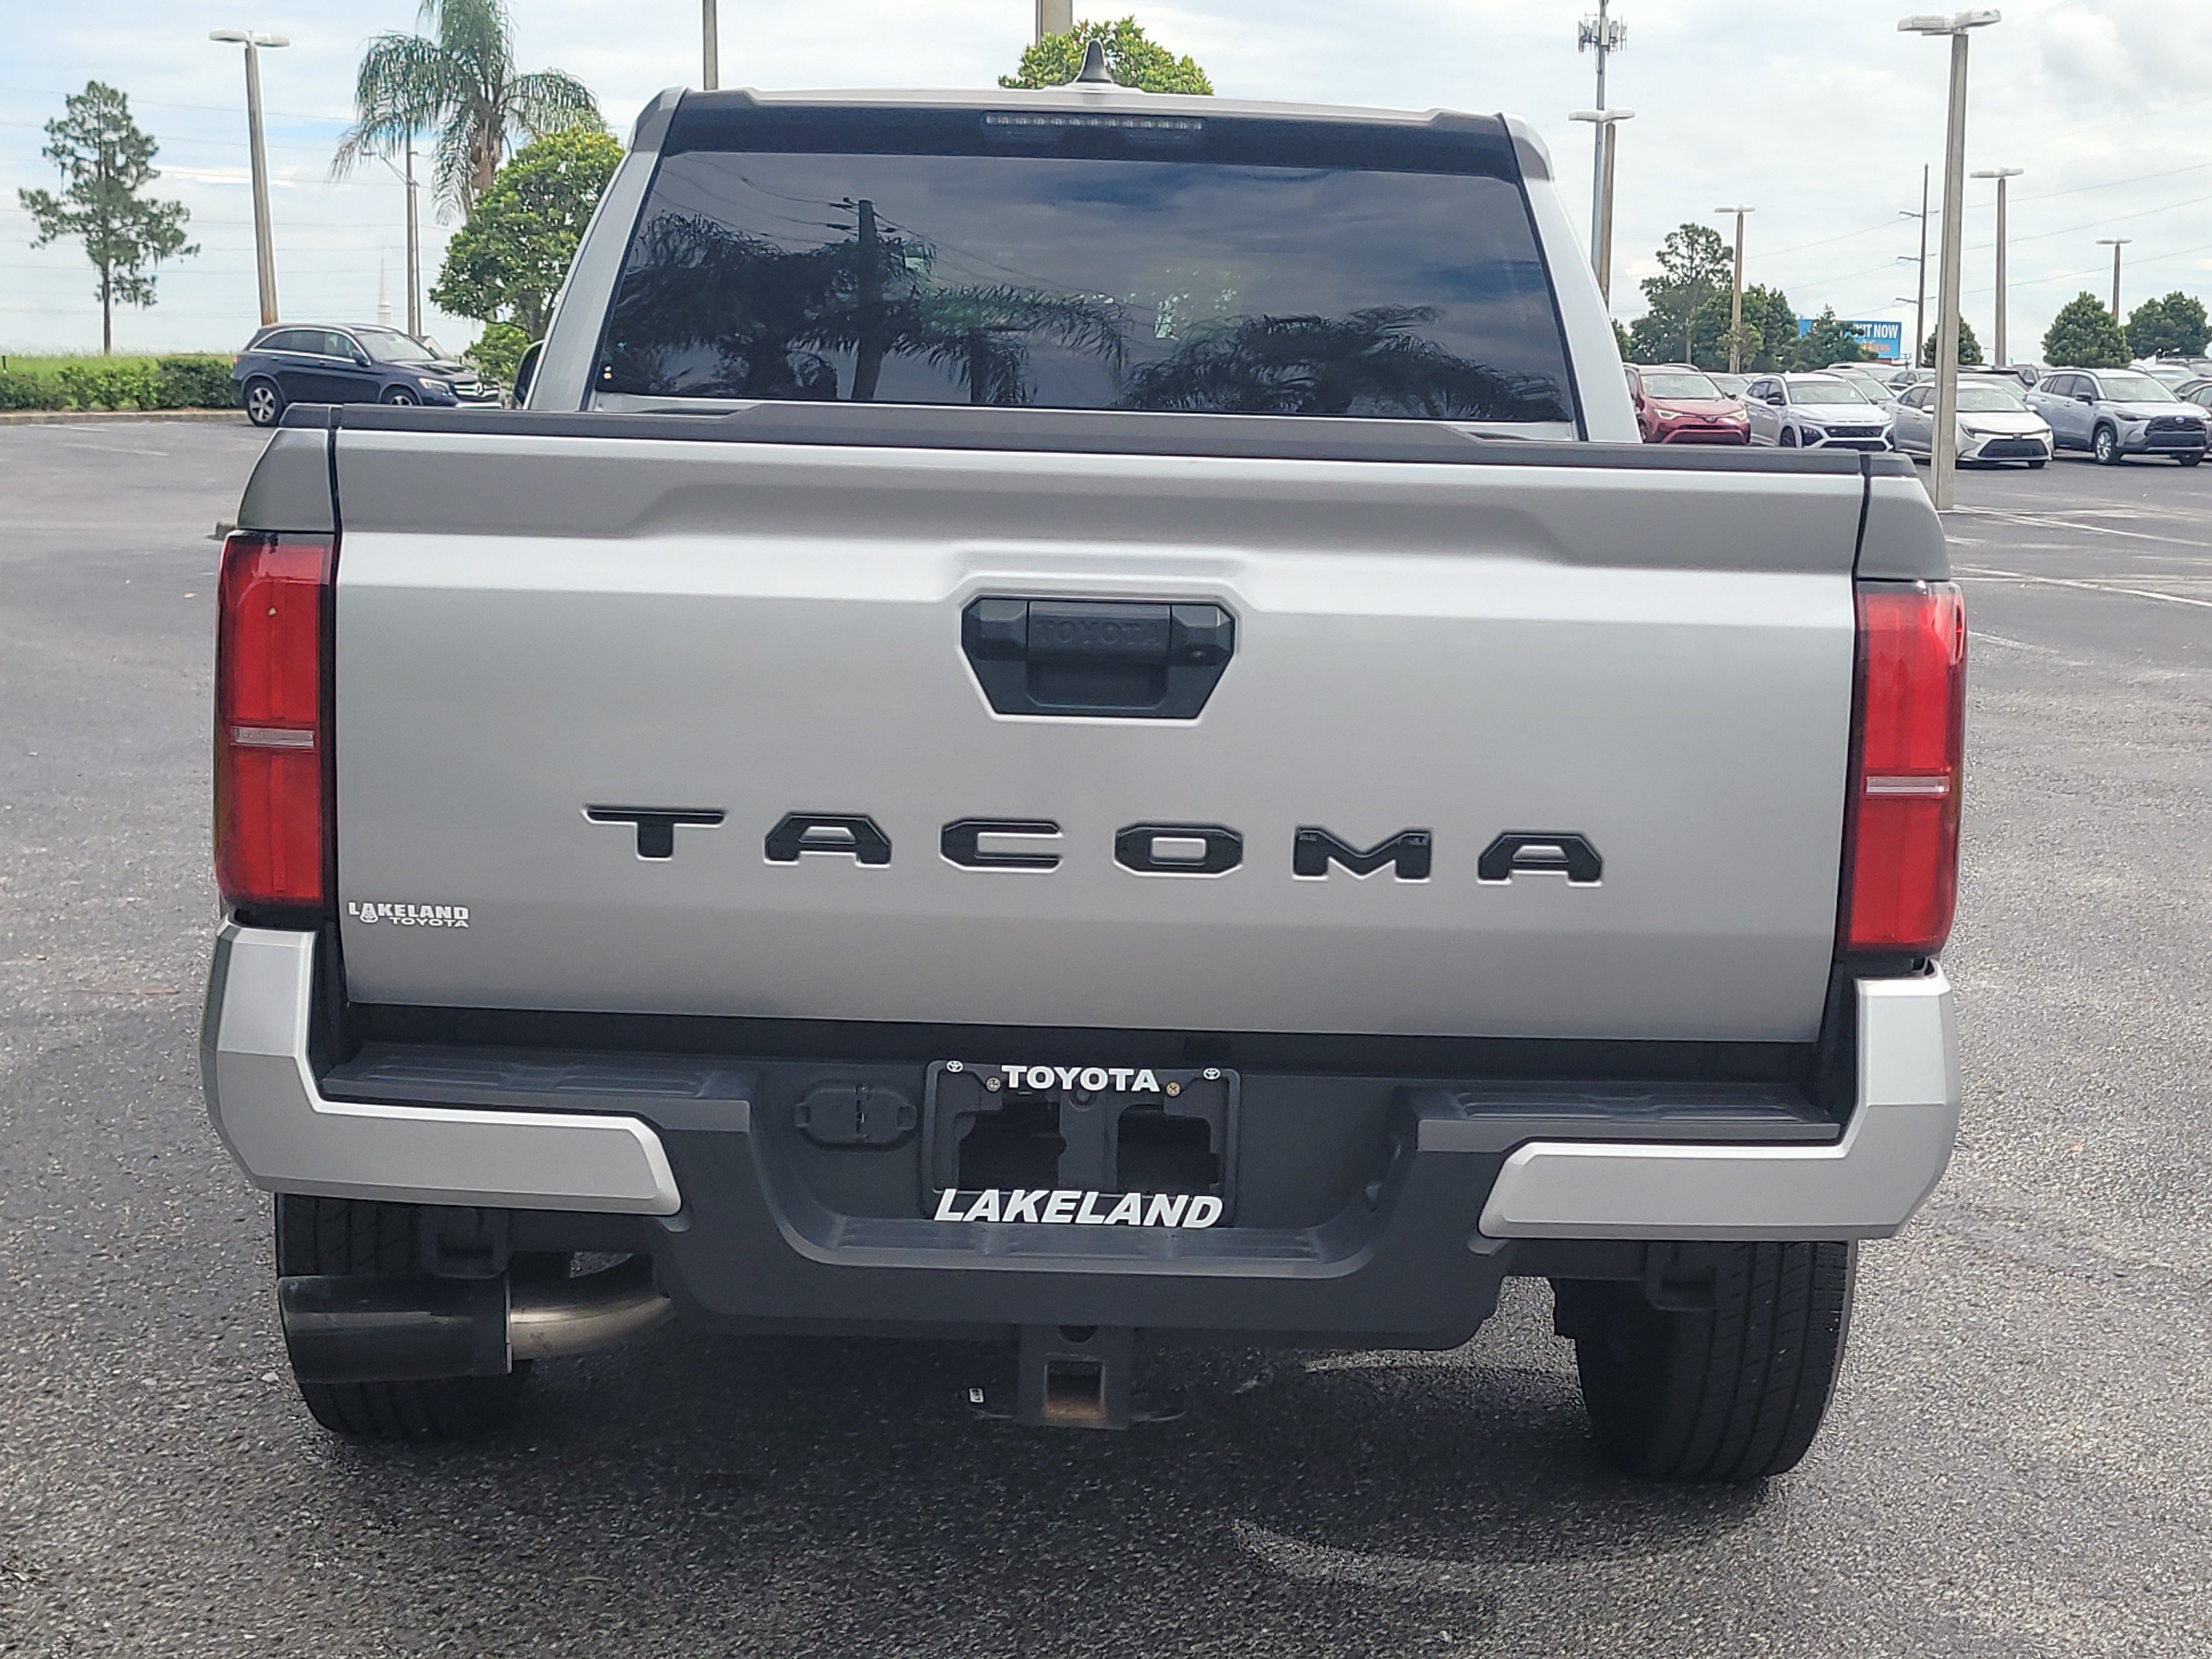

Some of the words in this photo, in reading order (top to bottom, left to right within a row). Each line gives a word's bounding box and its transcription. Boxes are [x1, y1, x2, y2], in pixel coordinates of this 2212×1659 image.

[1874, 324, 1898, 338] NOW
[585, 806, 1603, 884] TACOMA
[348, 902, 469, 923] LAKELAND
[389, 916, 470, 928] TOYOTA
[1001, 1065, 1160, 1092] TOYOTA
[933, 1188, 1223, 1229] LAKELAND
